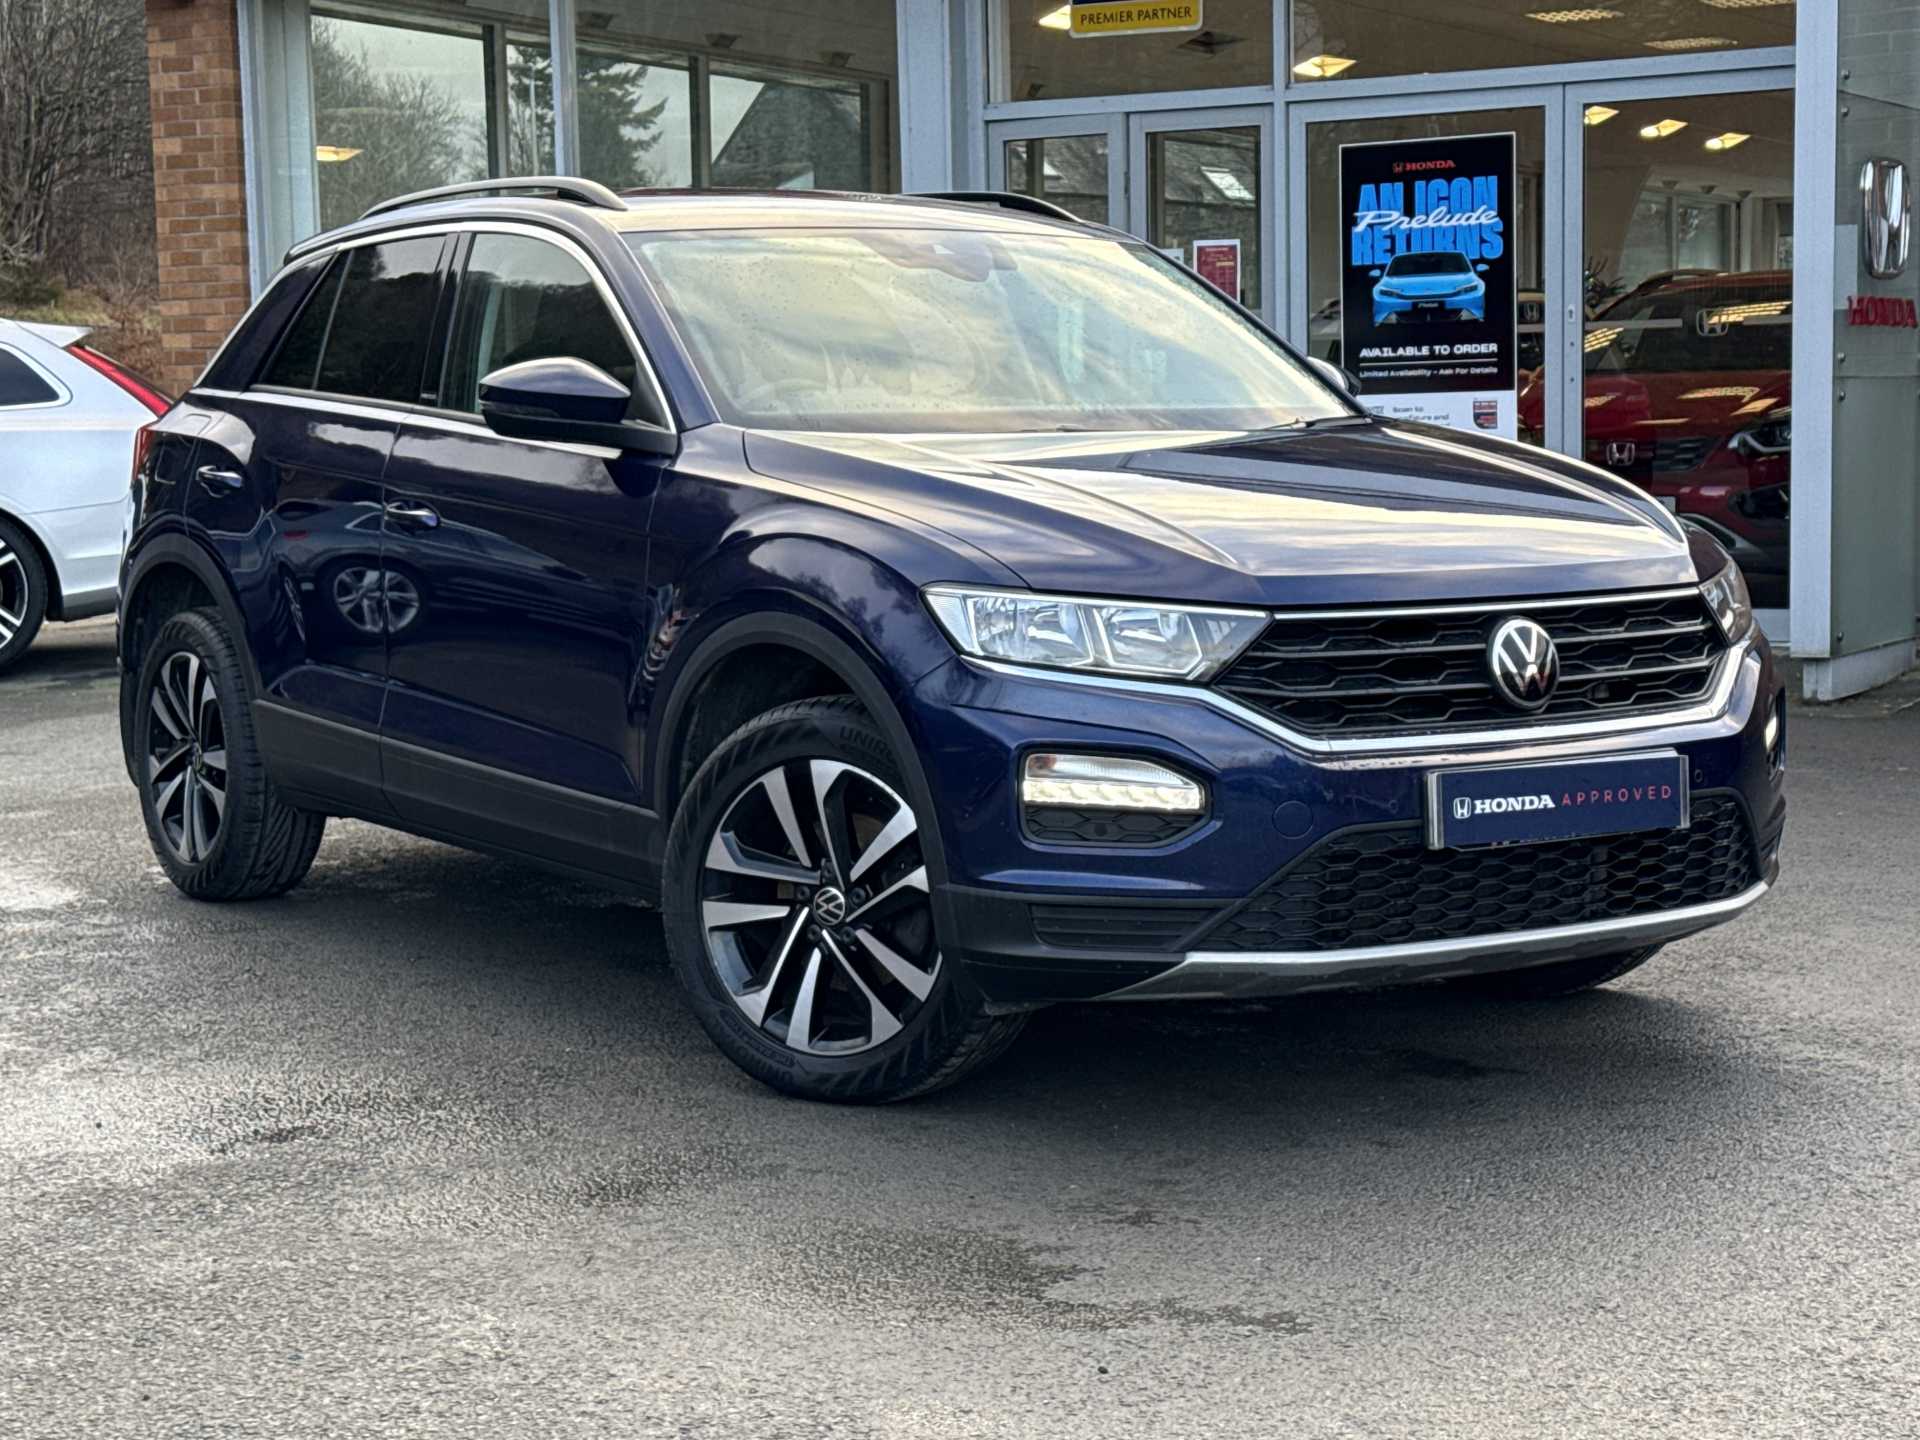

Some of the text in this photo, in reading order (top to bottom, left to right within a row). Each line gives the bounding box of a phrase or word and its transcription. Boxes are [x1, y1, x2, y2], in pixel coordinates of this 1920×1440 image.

[1080, 6, 1192, 25] PREMIER PARTNER
[1405, 160, 1456, 171] HONDA
[1357, 175, 1498, 222] AN ICON
[1354, 205, 1499, 232] Prelude
[1352, 218, 1504, 265] RETURNS
[1847, 295, 1918, 329] HONDA
[1359, 343, 1498, 358] AVAILABLE TO ORDER
[1473, 785, 1672, 815] HONDA APPROVED
